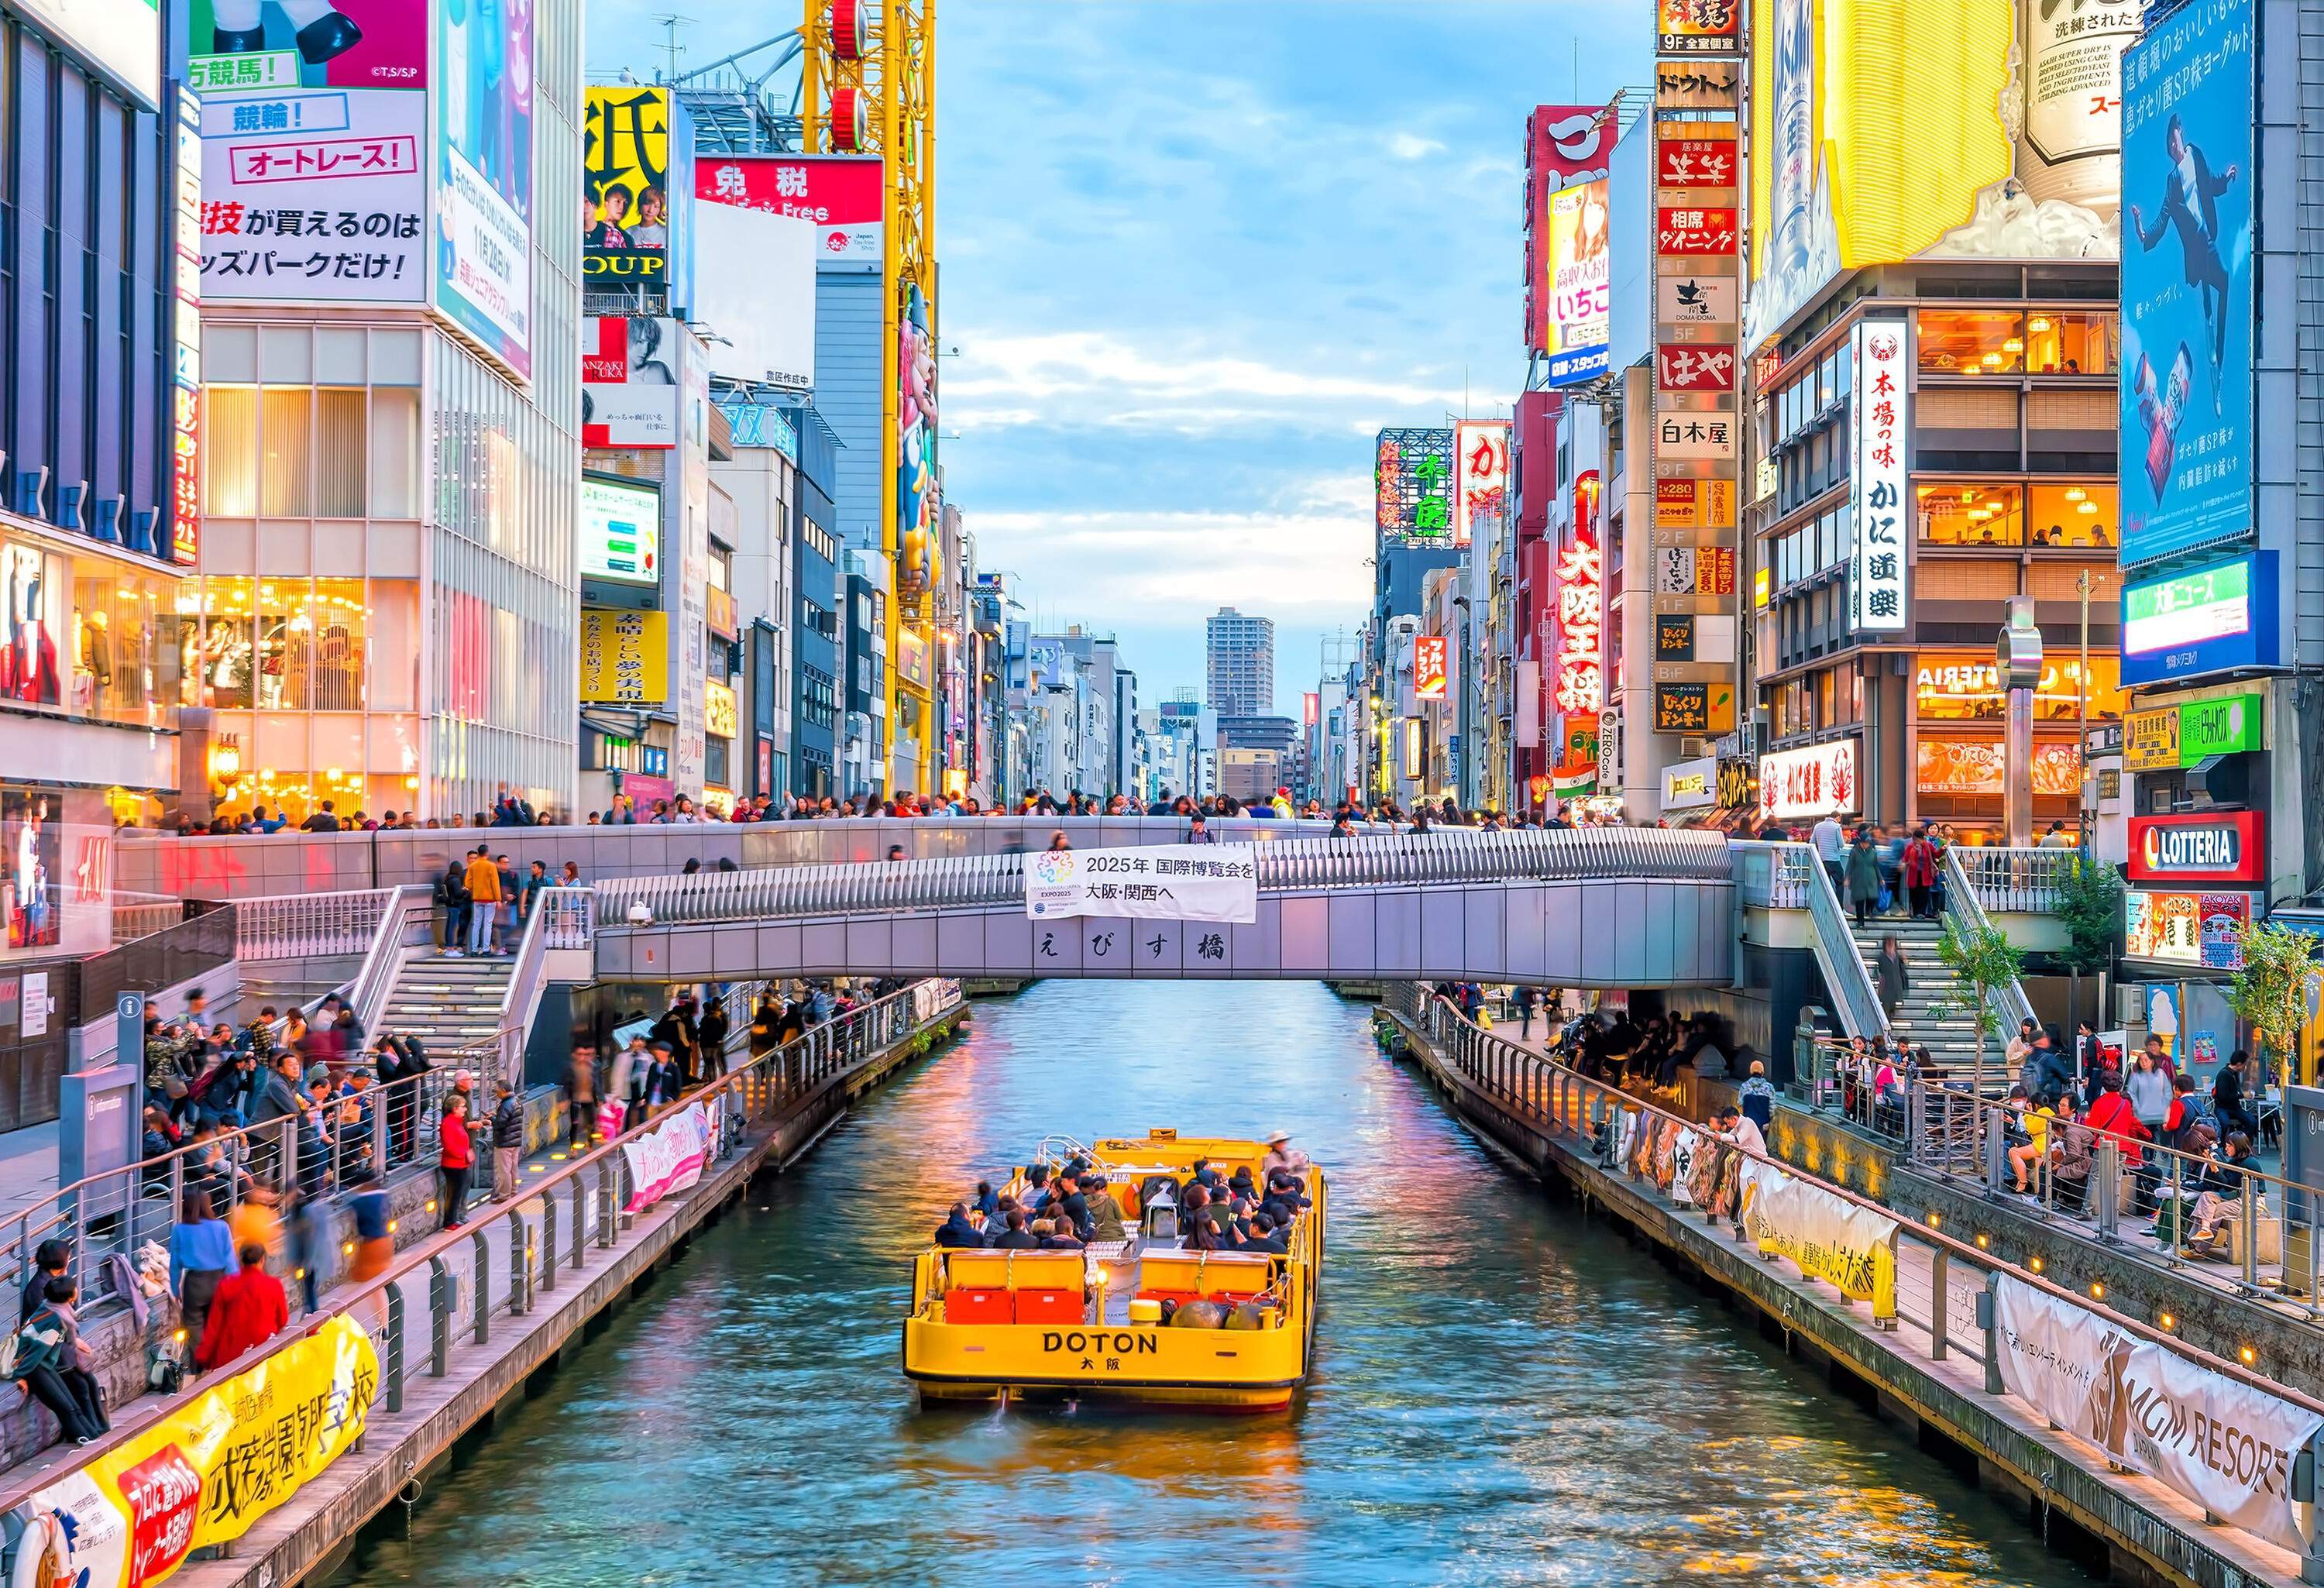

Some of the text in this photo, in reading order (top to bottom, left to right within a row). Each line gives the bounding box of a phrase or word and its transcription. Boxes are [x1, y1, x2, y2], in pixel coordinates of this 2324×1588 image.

[1665, 35, 1734, 50] 9F 全室個室
[2126, 0, 2248, 93] 道頓堀のおいしいもの
[2039, 56, 2057, 68] ASAHI
[2058, 50, 2082, 62] SUPER
[2084, 45, 2101, 57] DRY
[1671, 211, 1703, 229] 相席
[1660, 230, 1735, 250] ダイニング
[1675, 328, 1694, 339] 5F
[591, 368, 624, 380] RUKA
[765, 370, 809, 386] 意匠作成中
[1870, 370, 1896, 468] 本場の味
[1662, 419, 1729, 443] 白木屋
[1868, 479, 1898, 617] かに道楽
[1555, 541, 1601, 713] 大阪王将
[1662, 627, 1688, 638] びっくり
[587, 614, 601, 693] あなたのお店づくり
[1661, 638, 1689, 649] ドンキー
[615, 614, 644, 700] 素晴らしい夢の実現
[1429, 640, 1443, 675] ツルハ
[1662, 694, 1702, 710] びっくり
[1661, 711, 1704, 727] ドンキー
[1602, 728, 1612, 757] ZERO
[2162, 830, 2231, 864] LOTTERIA
[1086, 858, 1254, 878] 2025年 国際博覧会を
[1085, 883, 1174, 901] 大阪・関西へ
[1043, 1332, 1157, 1353] DOTON
[1080, 1356, 1120, 1370] 大阪
[2125, 1378, 2288, 1502] MGM RESORTS
